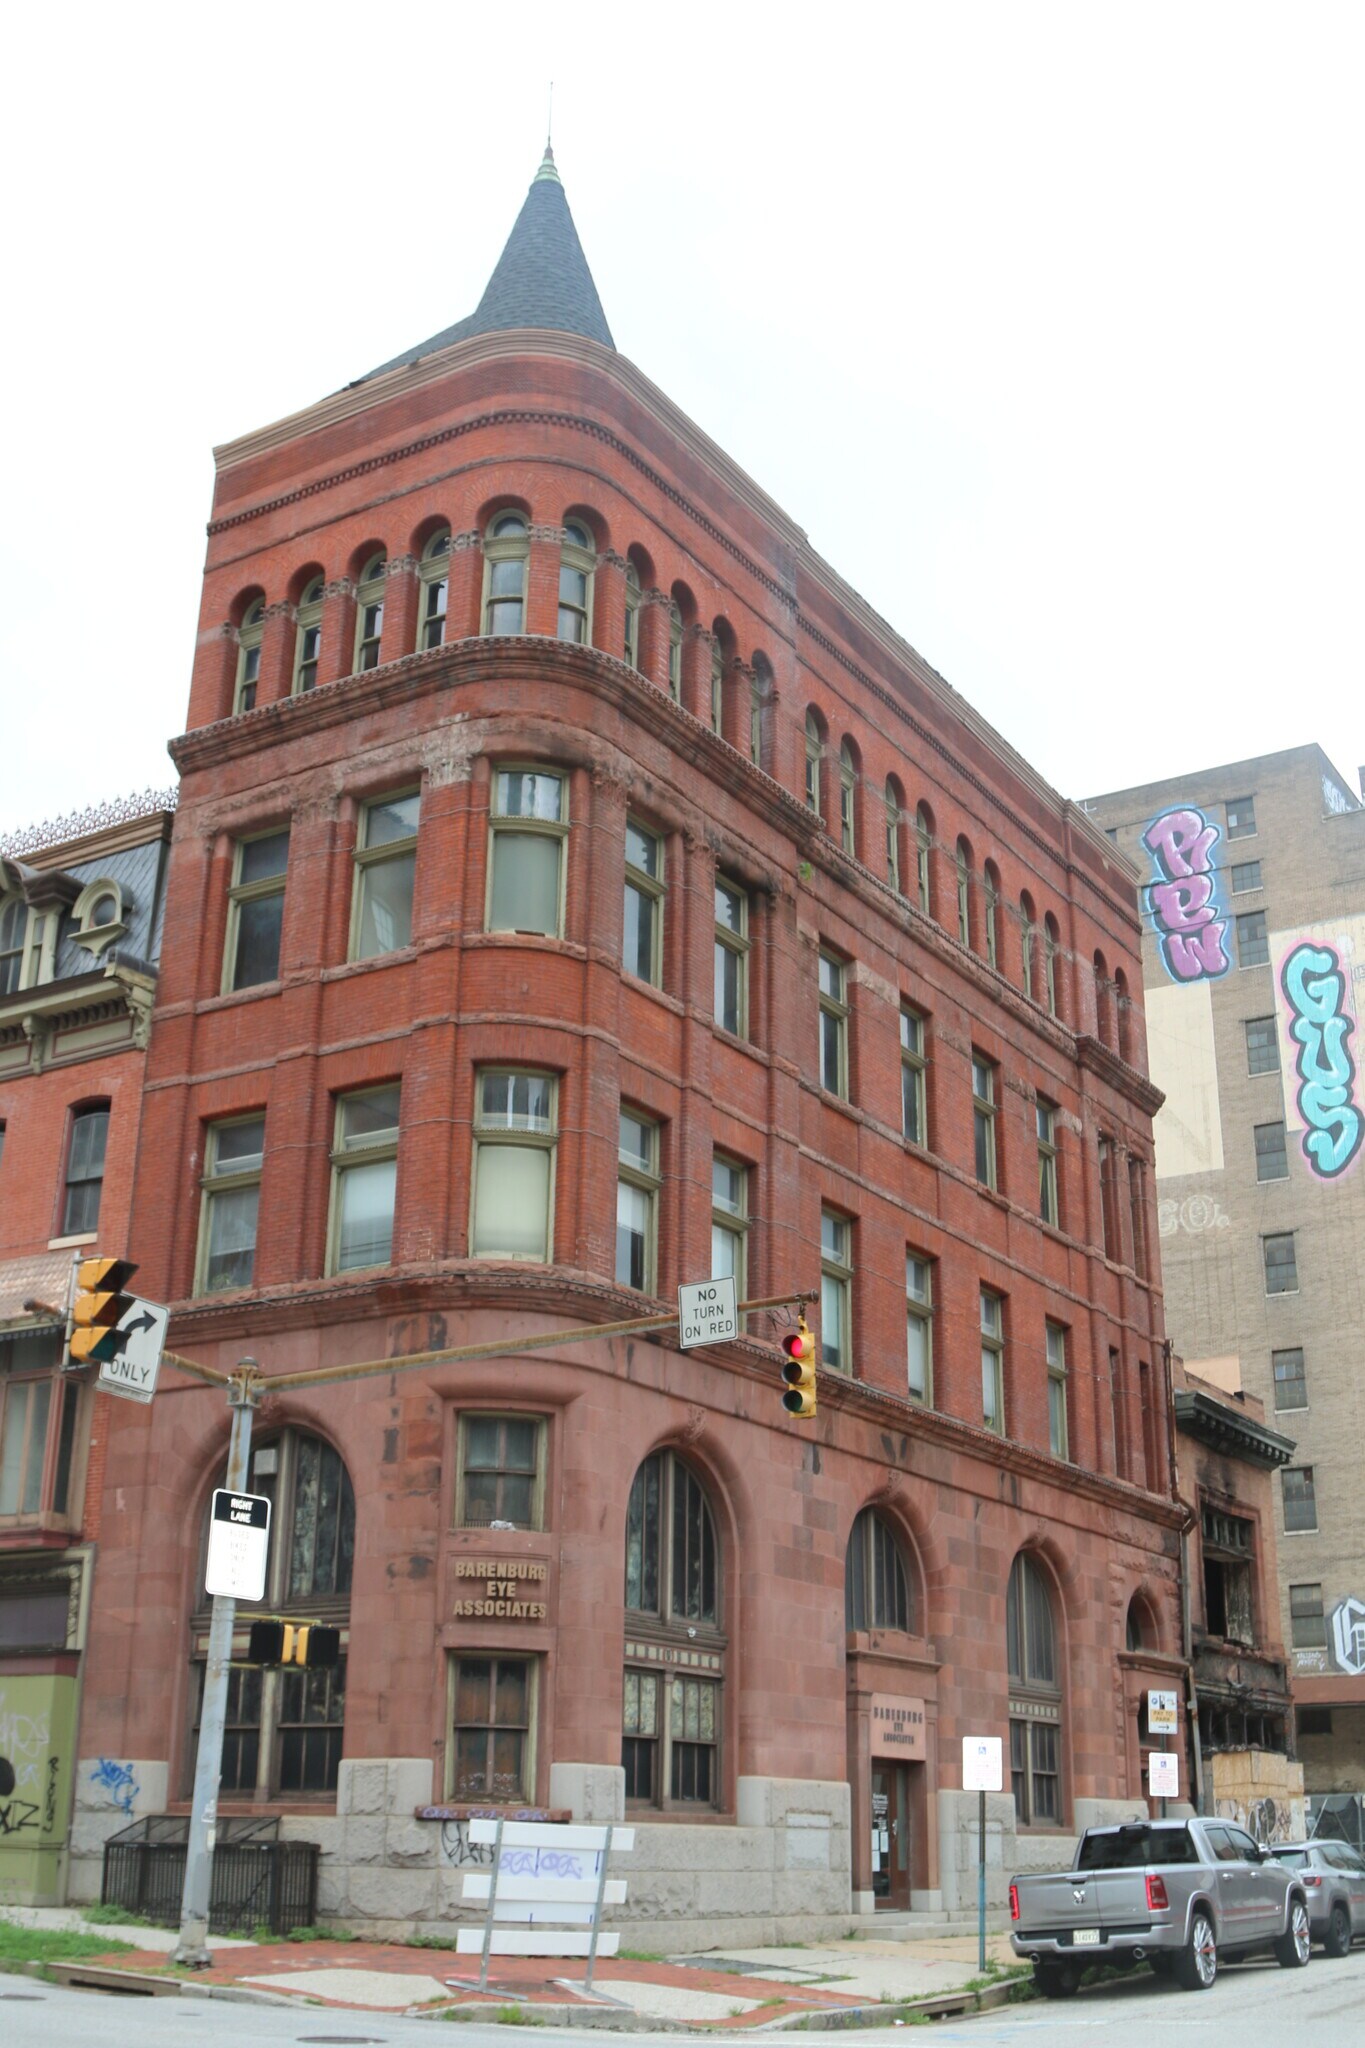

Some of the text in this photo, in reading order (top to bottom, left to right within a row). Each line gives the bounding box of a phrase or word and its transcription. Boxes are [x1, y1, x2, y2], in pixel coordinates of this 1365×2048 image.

[698, 1288, 717, 1302] NO
[693, 1304, 724, 1320] TURN
[685, 1320, 733, 1339] ON RED
[110, 1359, 150, 1384] ONLY
[230, 1498, 253, 1511] RIGHT
[230, 1510, 251, 1523] LANE
[455, 1562, 546, 1580] BARENBURG
[487, 1580, 516, 1597] EYE
[453, 1599, 546, 1619] ASSOCIATES
